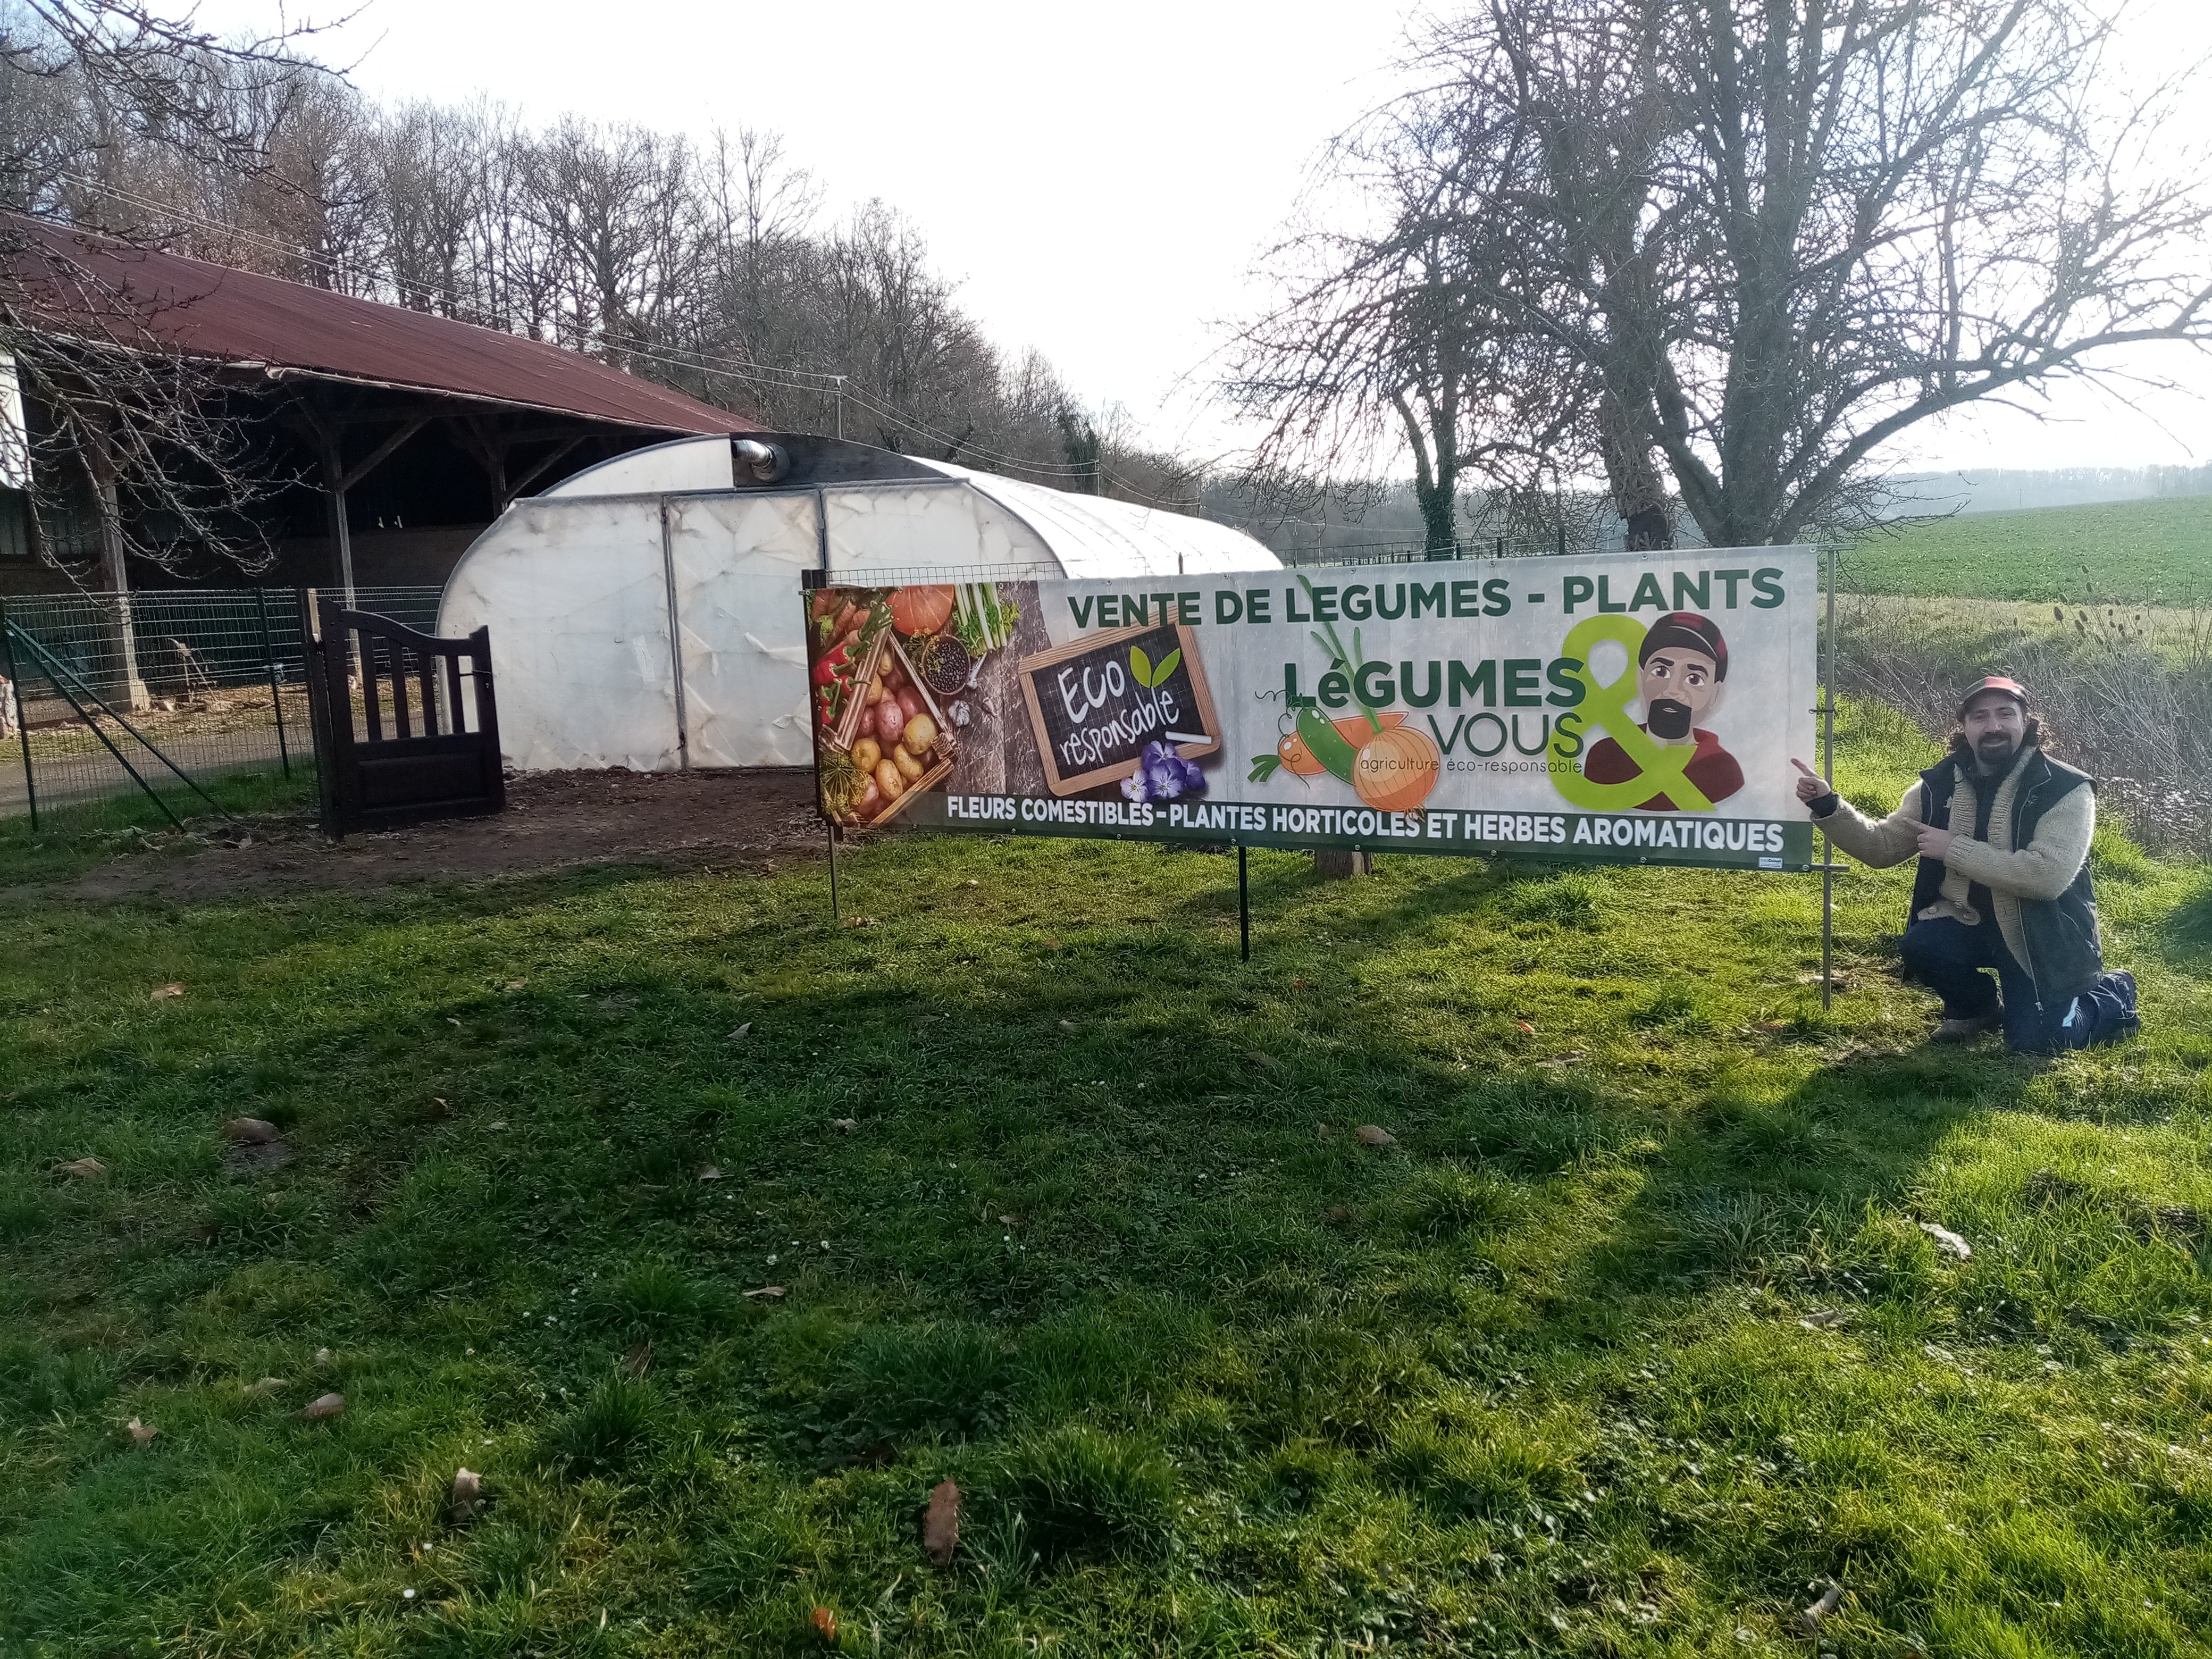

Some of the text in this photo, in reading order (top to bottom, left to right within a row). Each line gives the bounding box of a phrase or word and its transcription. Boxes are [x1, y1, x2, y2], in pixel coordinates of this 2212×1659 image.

[1067, 591, 1202, 628] VENTE
[1214, 589, 1271, 625] DE
[1286, 579, 1512, 623] LEGUMES
[1563, 567, 1786, 614] PLANTS
[1059, 685, 1179, 766] responsable
[1426, 712, 1584, 758] VOUS
[1360, 757, 1582, 774] agriculture éco-responsable
[947, 795, 1017, 820] FLEURS
[1272, 807, 1421, 839] HORTICOLES
[1426, 812, 1457, 839] ET
[1464, 814, 1566, 844] HERBES
[1572, 817, 1784, 852] AROMATIQUES
